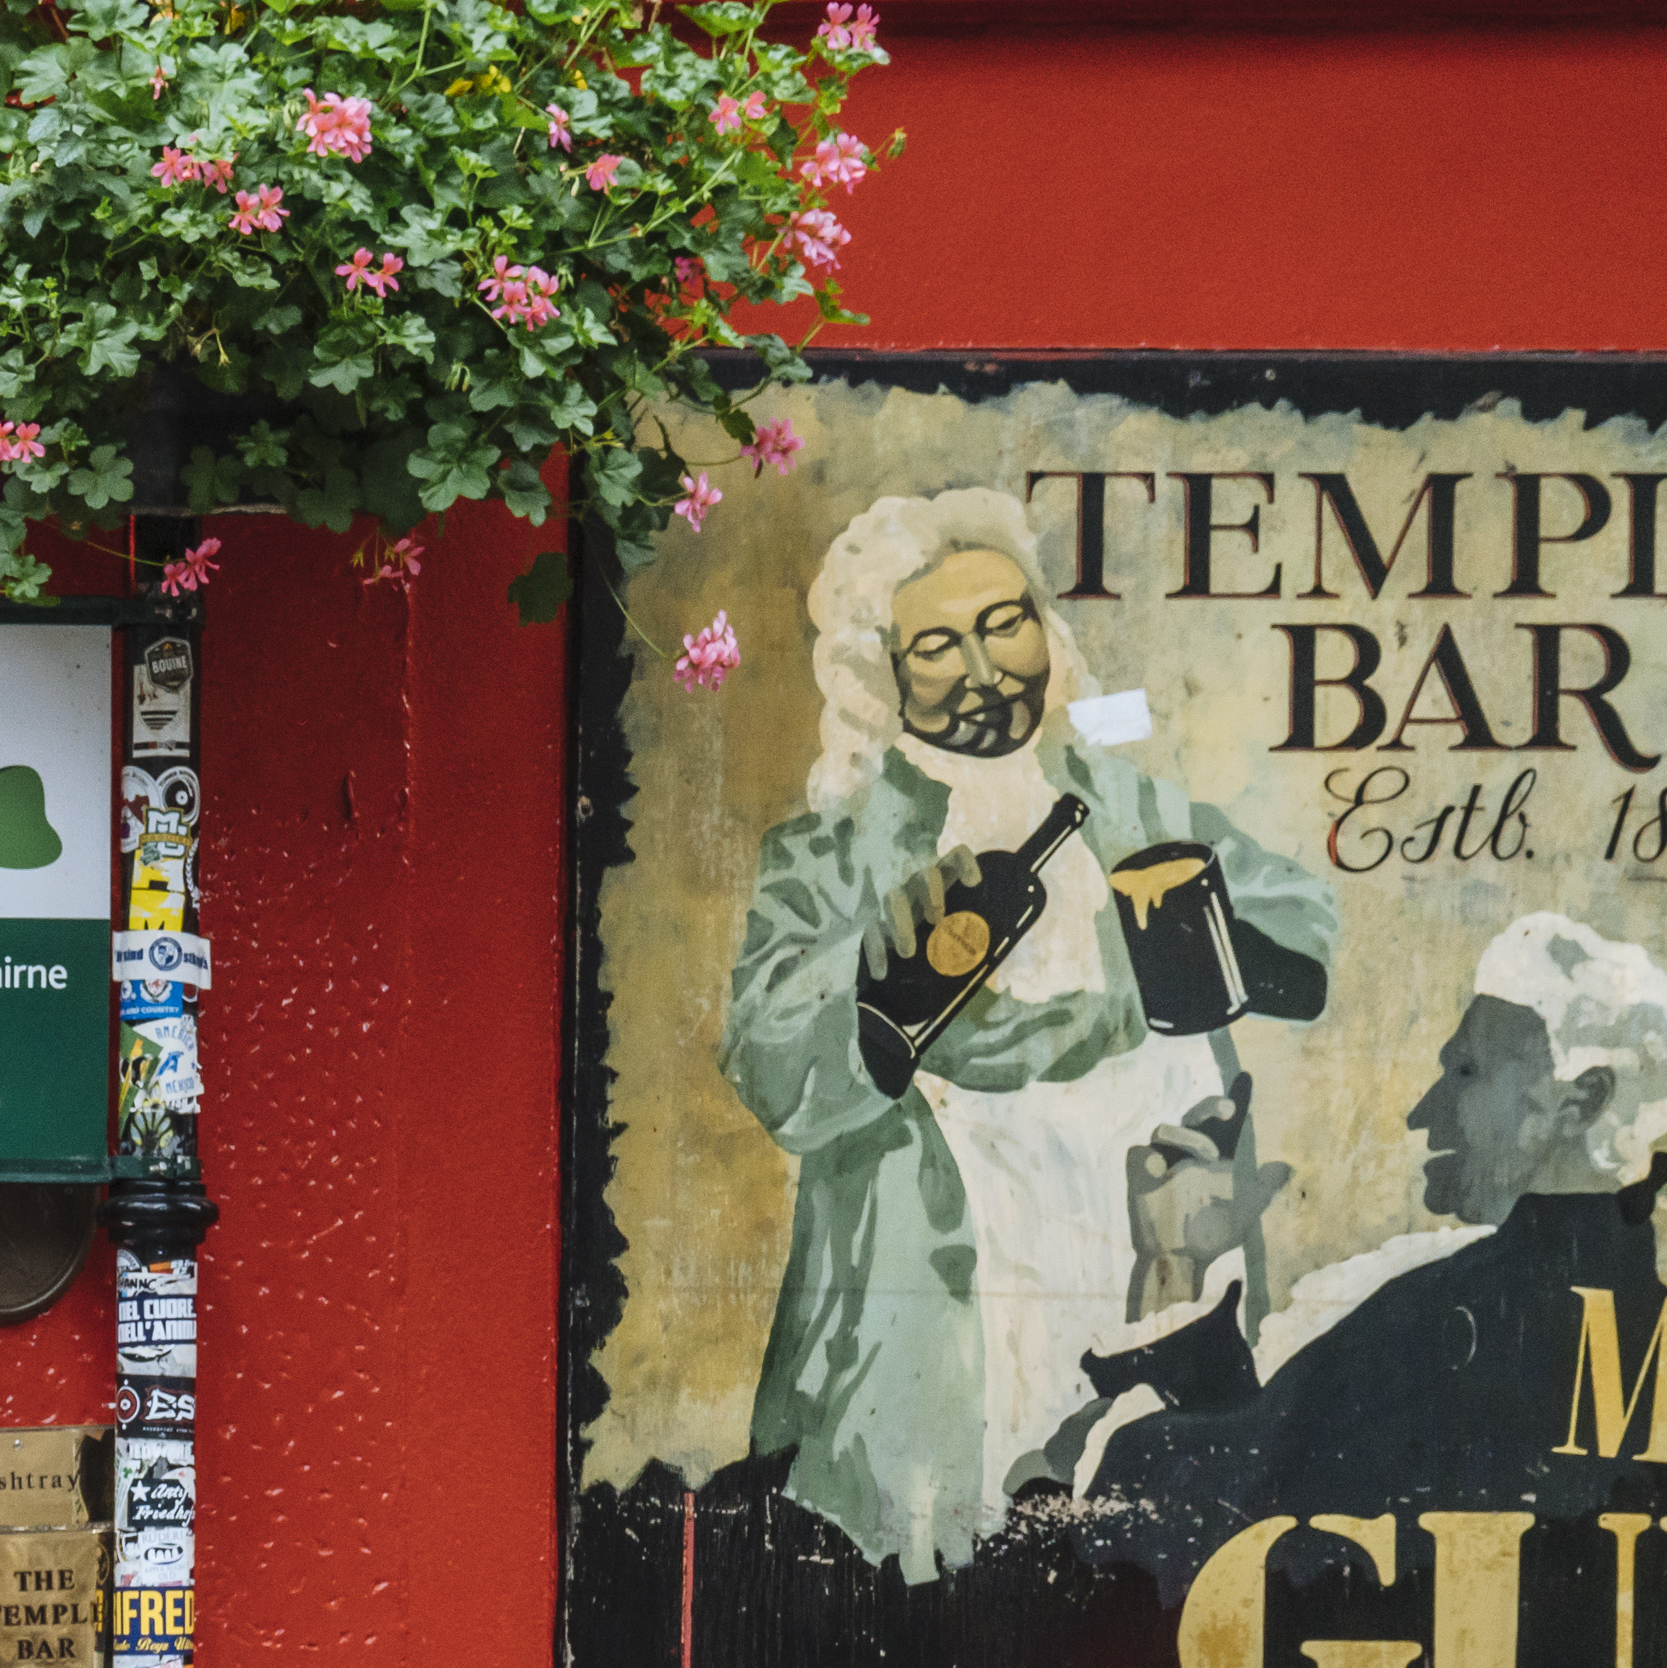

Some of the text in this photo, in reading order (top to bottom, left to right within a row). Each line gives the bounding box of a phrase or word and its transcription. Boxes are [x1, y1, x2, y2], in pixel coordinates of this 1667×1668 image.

[1268, 622, 1661, 773] BAR
[1324, 766, 1537, 873] Estb.
[14, 1568, 75, 1592] THE
[17, 1637, 76, 1661] BAR
